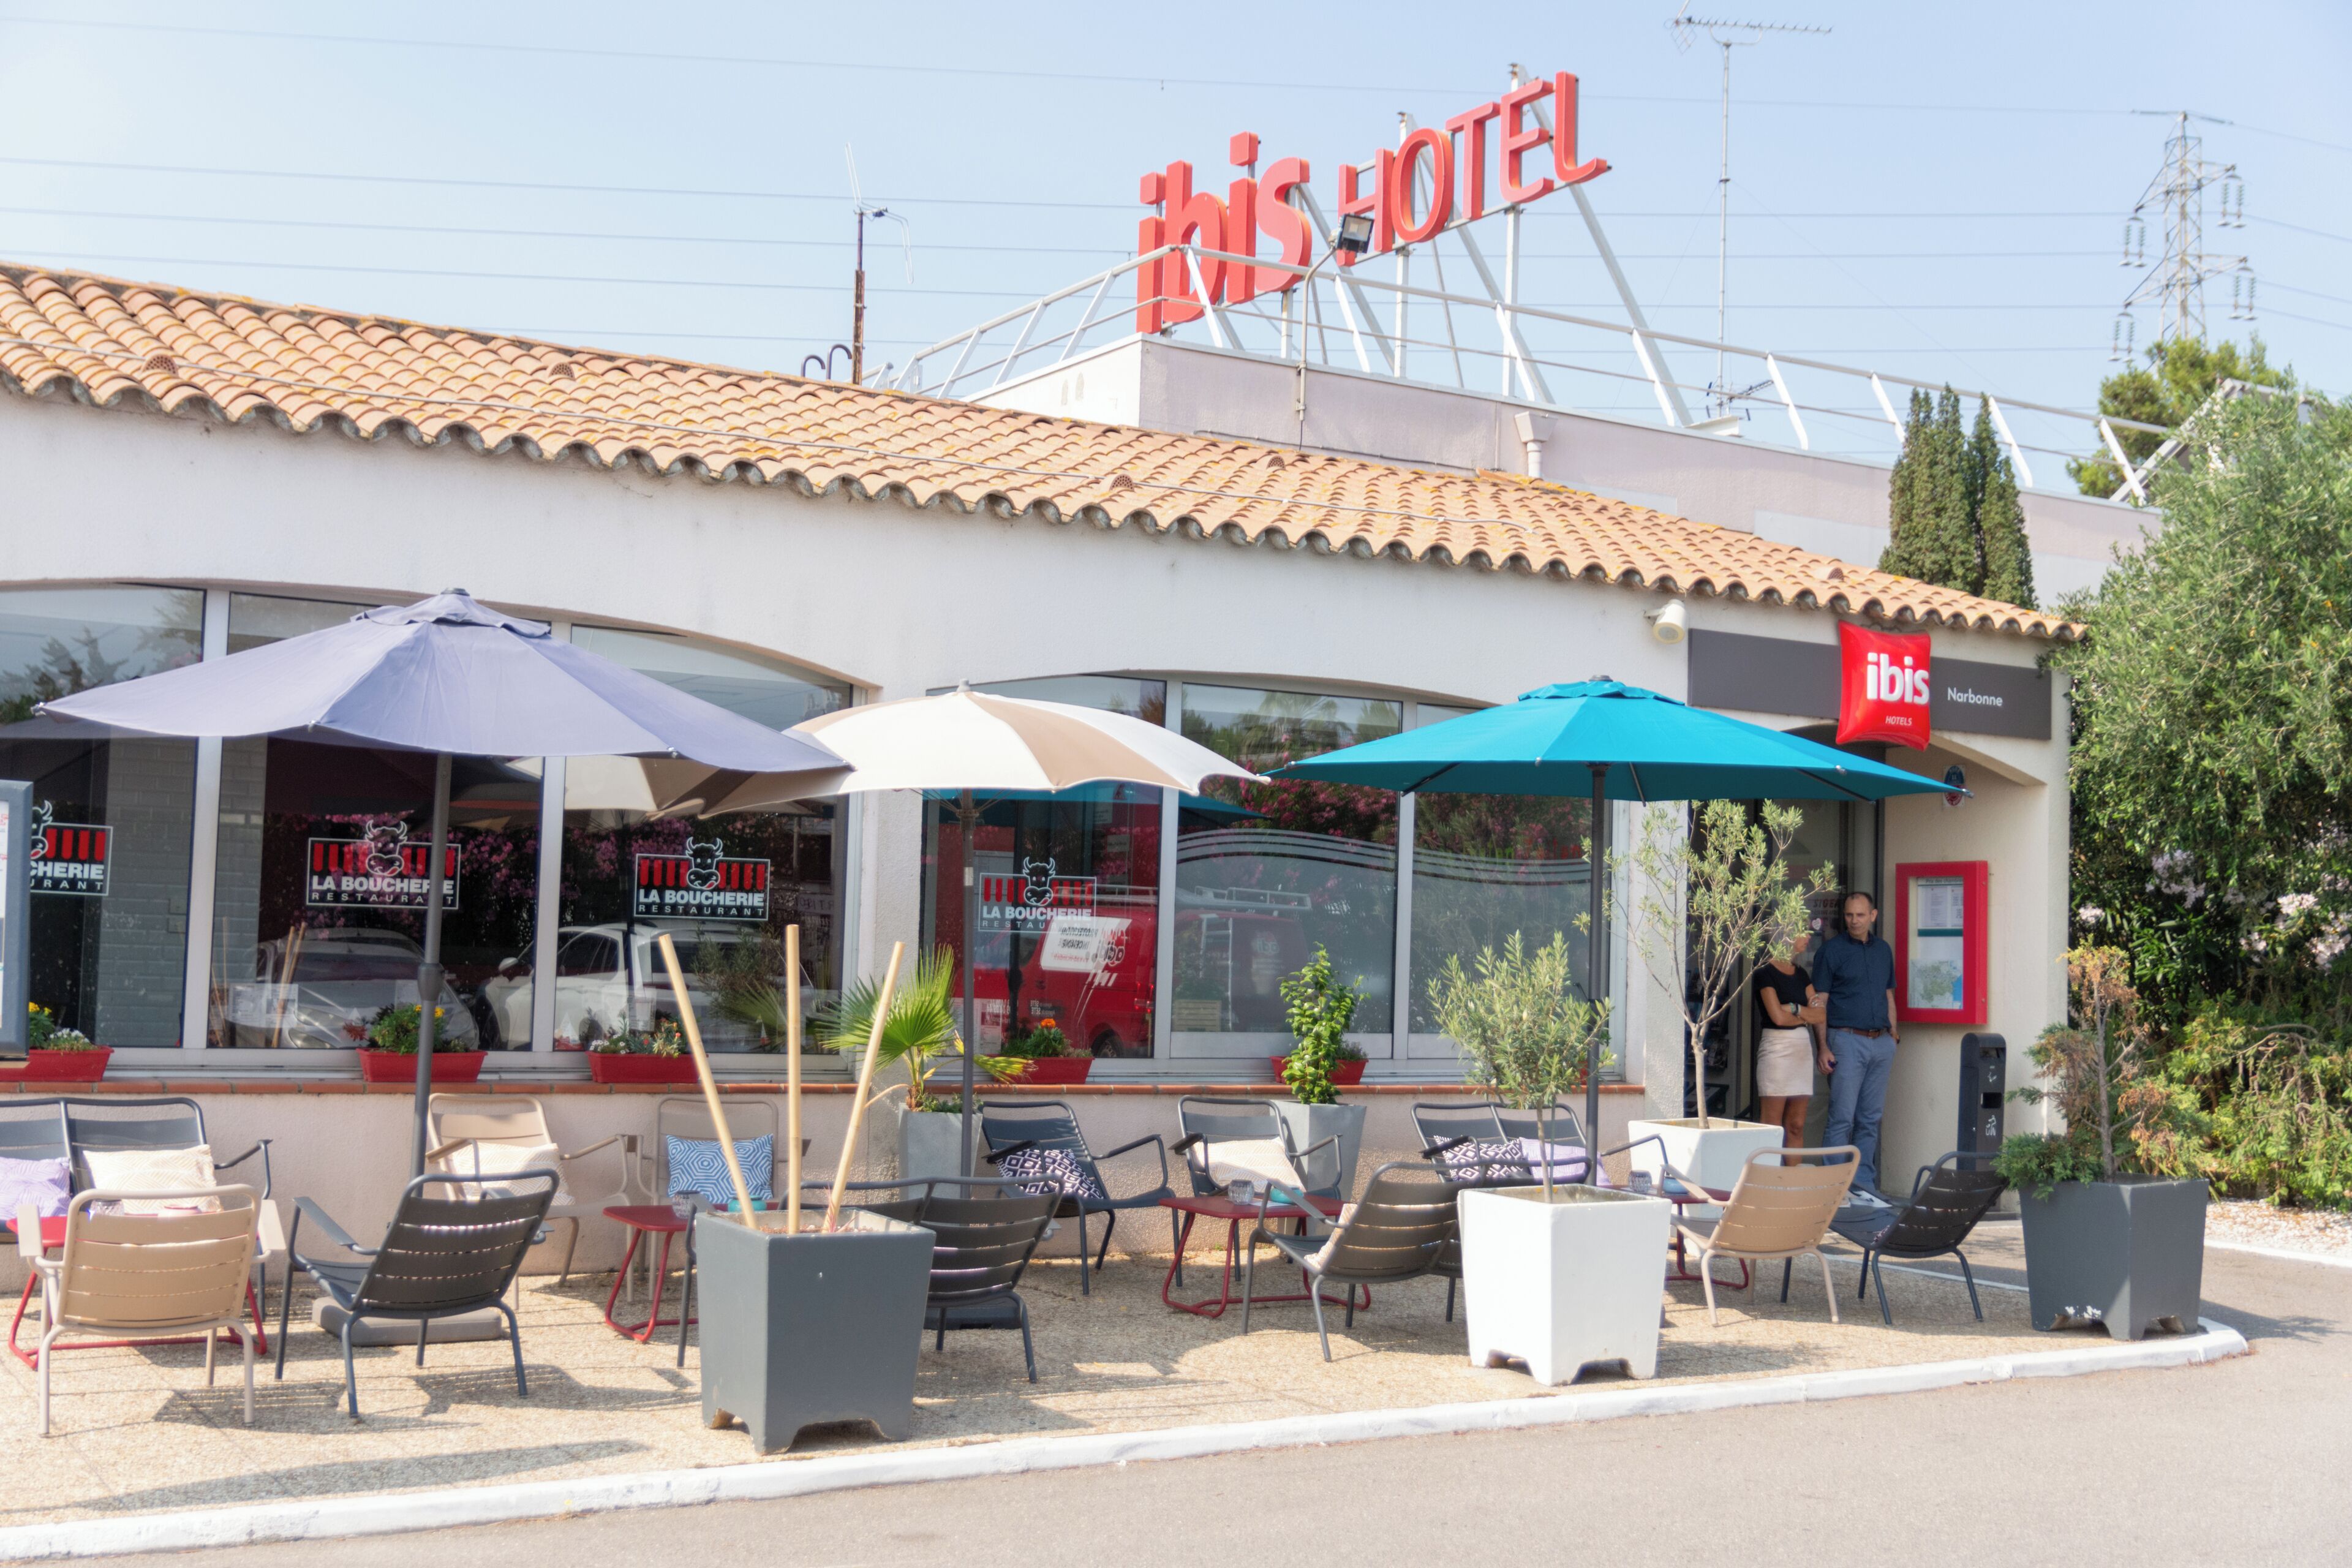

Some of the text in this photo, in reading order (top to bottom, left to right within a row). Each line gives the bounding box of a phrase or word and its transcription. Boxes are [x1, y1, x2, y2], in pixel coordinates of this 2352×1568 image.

[1136, 70, 1608, 334] ibis HOTEL
[1866, 652, 1929, 705] ibis
[1947, 687, 2003, 707] Narbonne
[1885, 715, 1912, 726] HOTELS
[30, 861, 104, 880] CHERIE
[312, 875, 454, 894] LA BOUCHERE
[312, 892, 454, 905] RESTAURAT
[639, 889, 764, 907] LA BOUCHERIE
[639, 905, 764, 916] RESTAURANT
[982, 905, 1092, 921] LA BOUCHERIE
